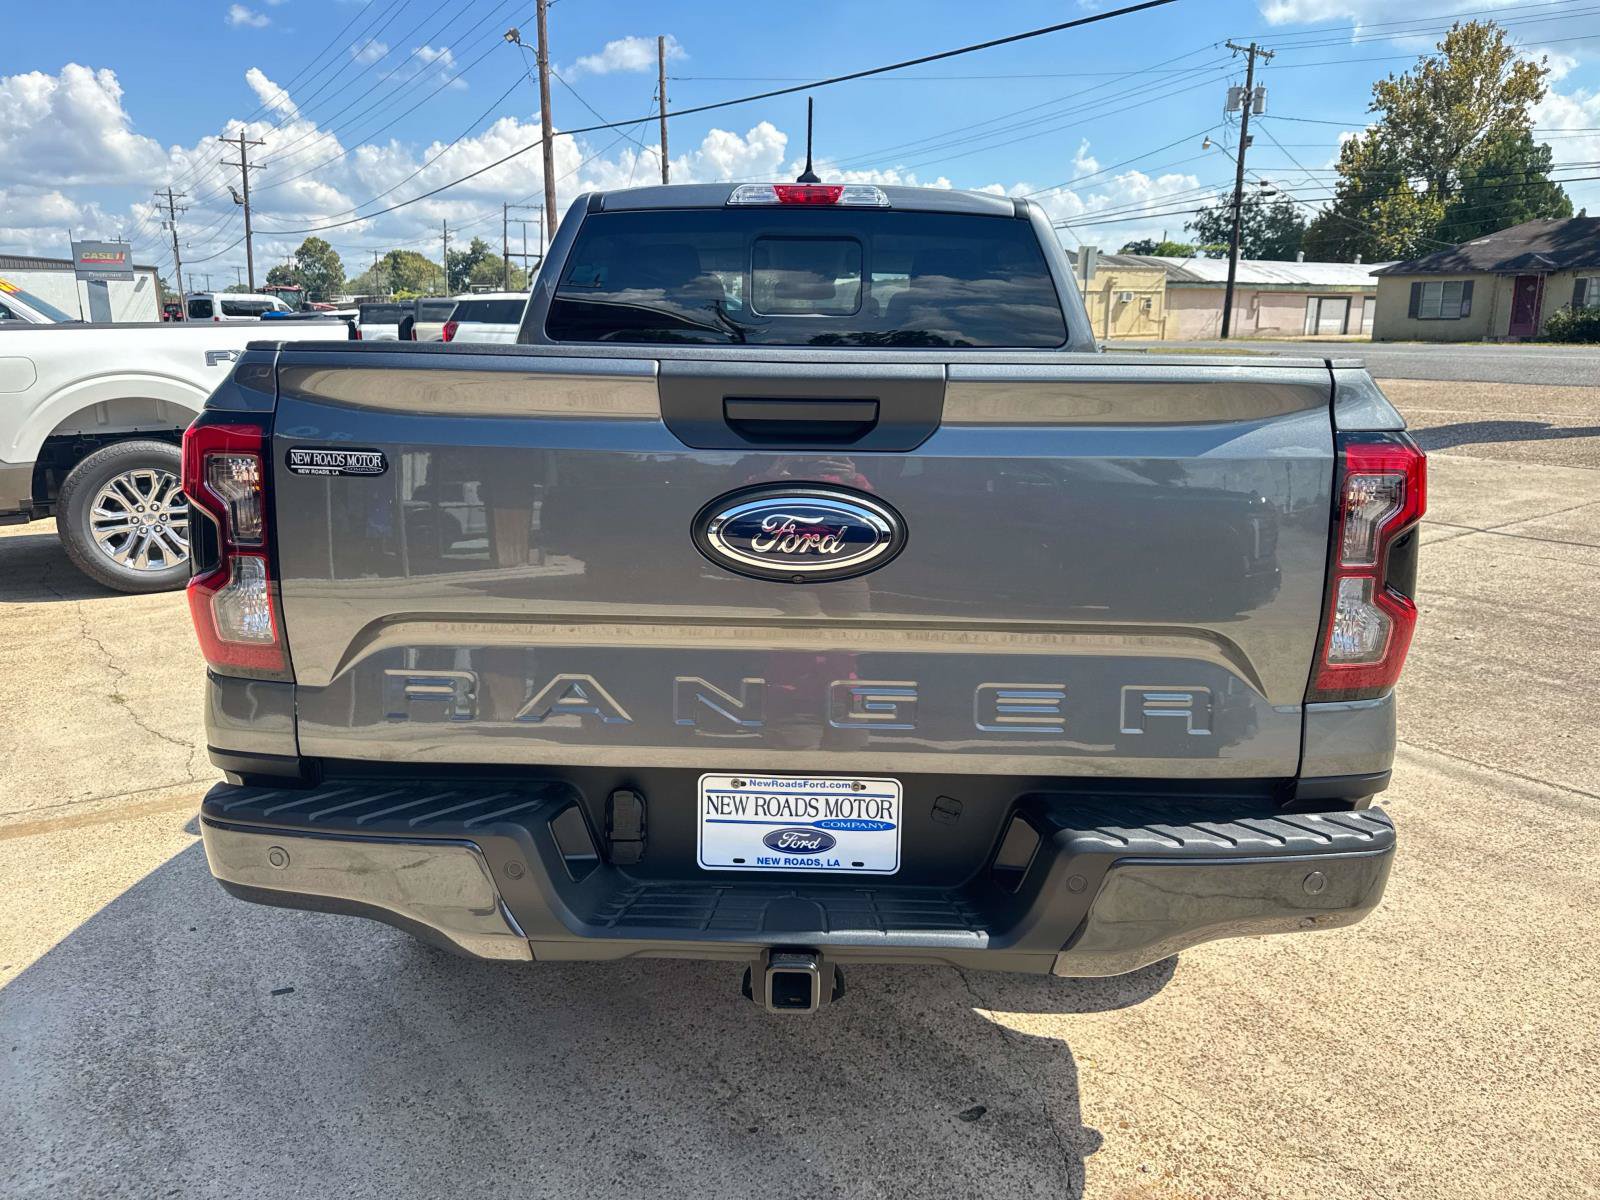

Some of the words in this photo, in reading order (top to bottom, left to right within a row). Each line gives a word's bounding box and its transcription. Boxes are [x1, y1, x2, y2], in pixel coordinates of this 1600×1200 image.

[82, 252, 113, 260] CASE
[290, 452, 312, 464] NEW
[313, 453, 346, 466] ROADS
[346, 454, 382, 467] MOTOR
[751, 513, 848, 554] Ford
[384, 669, 1214, 735] RANGER
[749, 779, 851, 790] NewRoadsFord.com
[706, 795, 750, 817] NEW
[754, 796, 820, 818] ROADS
[824, 798, 894, 820] MOTOR
[821, 821, 887, 830] COMPANY
[778, 831, 822, 850] Ford
[756, 857, 781, 866] NEW
[784, 858, 824, 868] ROADS,
[827, 859, 841, 867] LA
